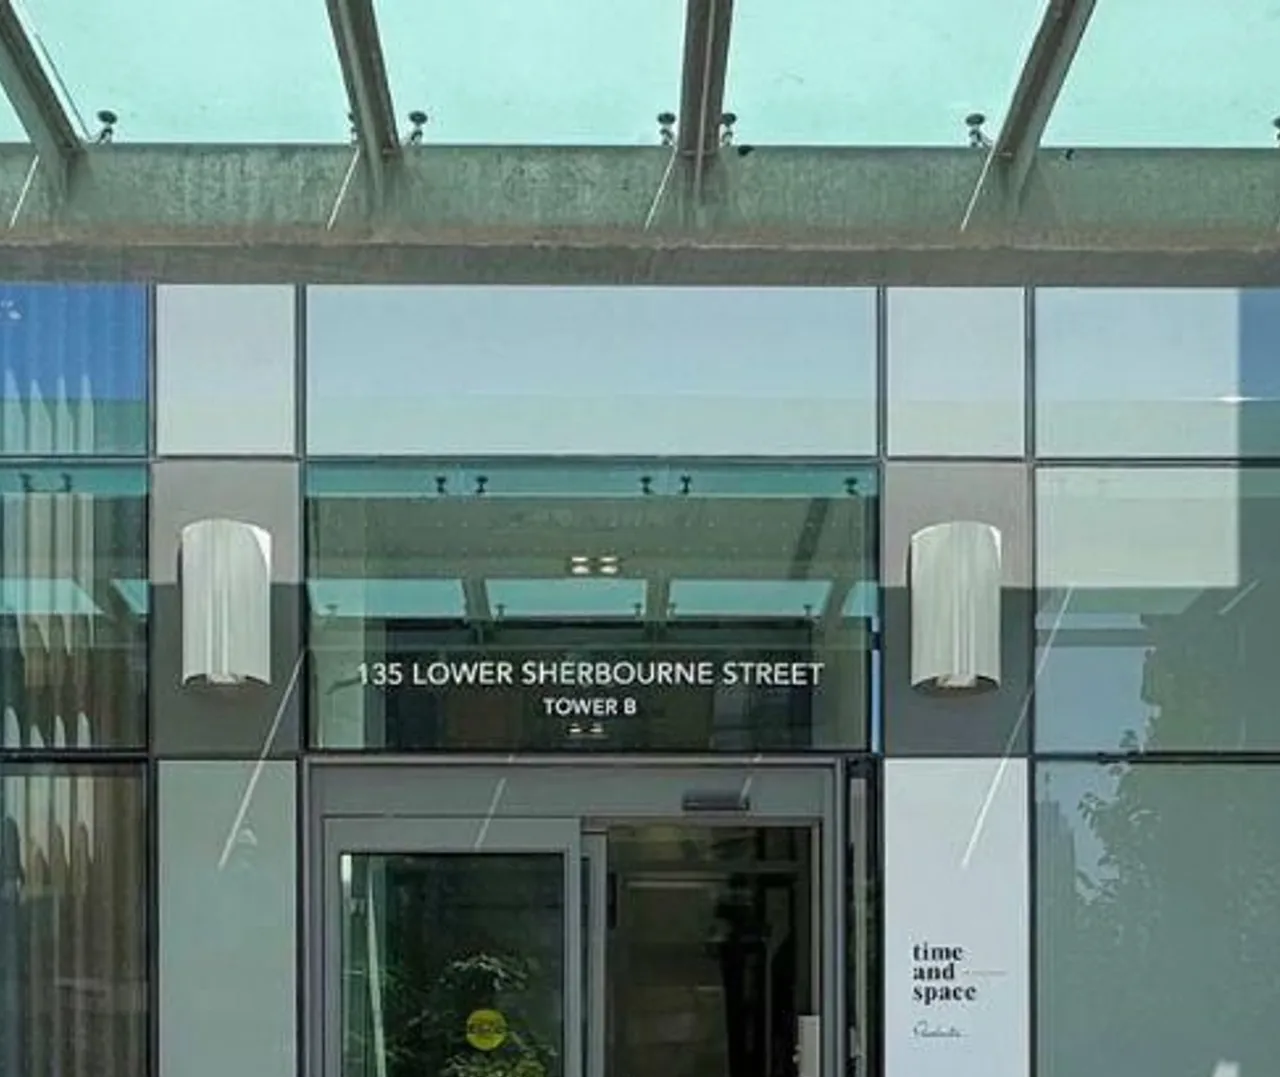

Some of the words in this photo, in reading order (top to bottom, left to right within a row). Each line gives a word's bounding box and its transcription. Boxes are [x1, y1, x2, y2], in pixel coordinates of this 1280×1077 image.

[357, 661, 403, 685] 135
[413, 661, 514, 685] LOWER
[521, 661, 713, 685] SHERBOURNE
[723, 661, 825, 685] STREET
[542, 697, 618, 715] TOWER
[624, 697, 637, 715] B
[913, 941, 963, 961] time
[913, 962, 955, 981] and
[913, 986, 977, 1006] space
